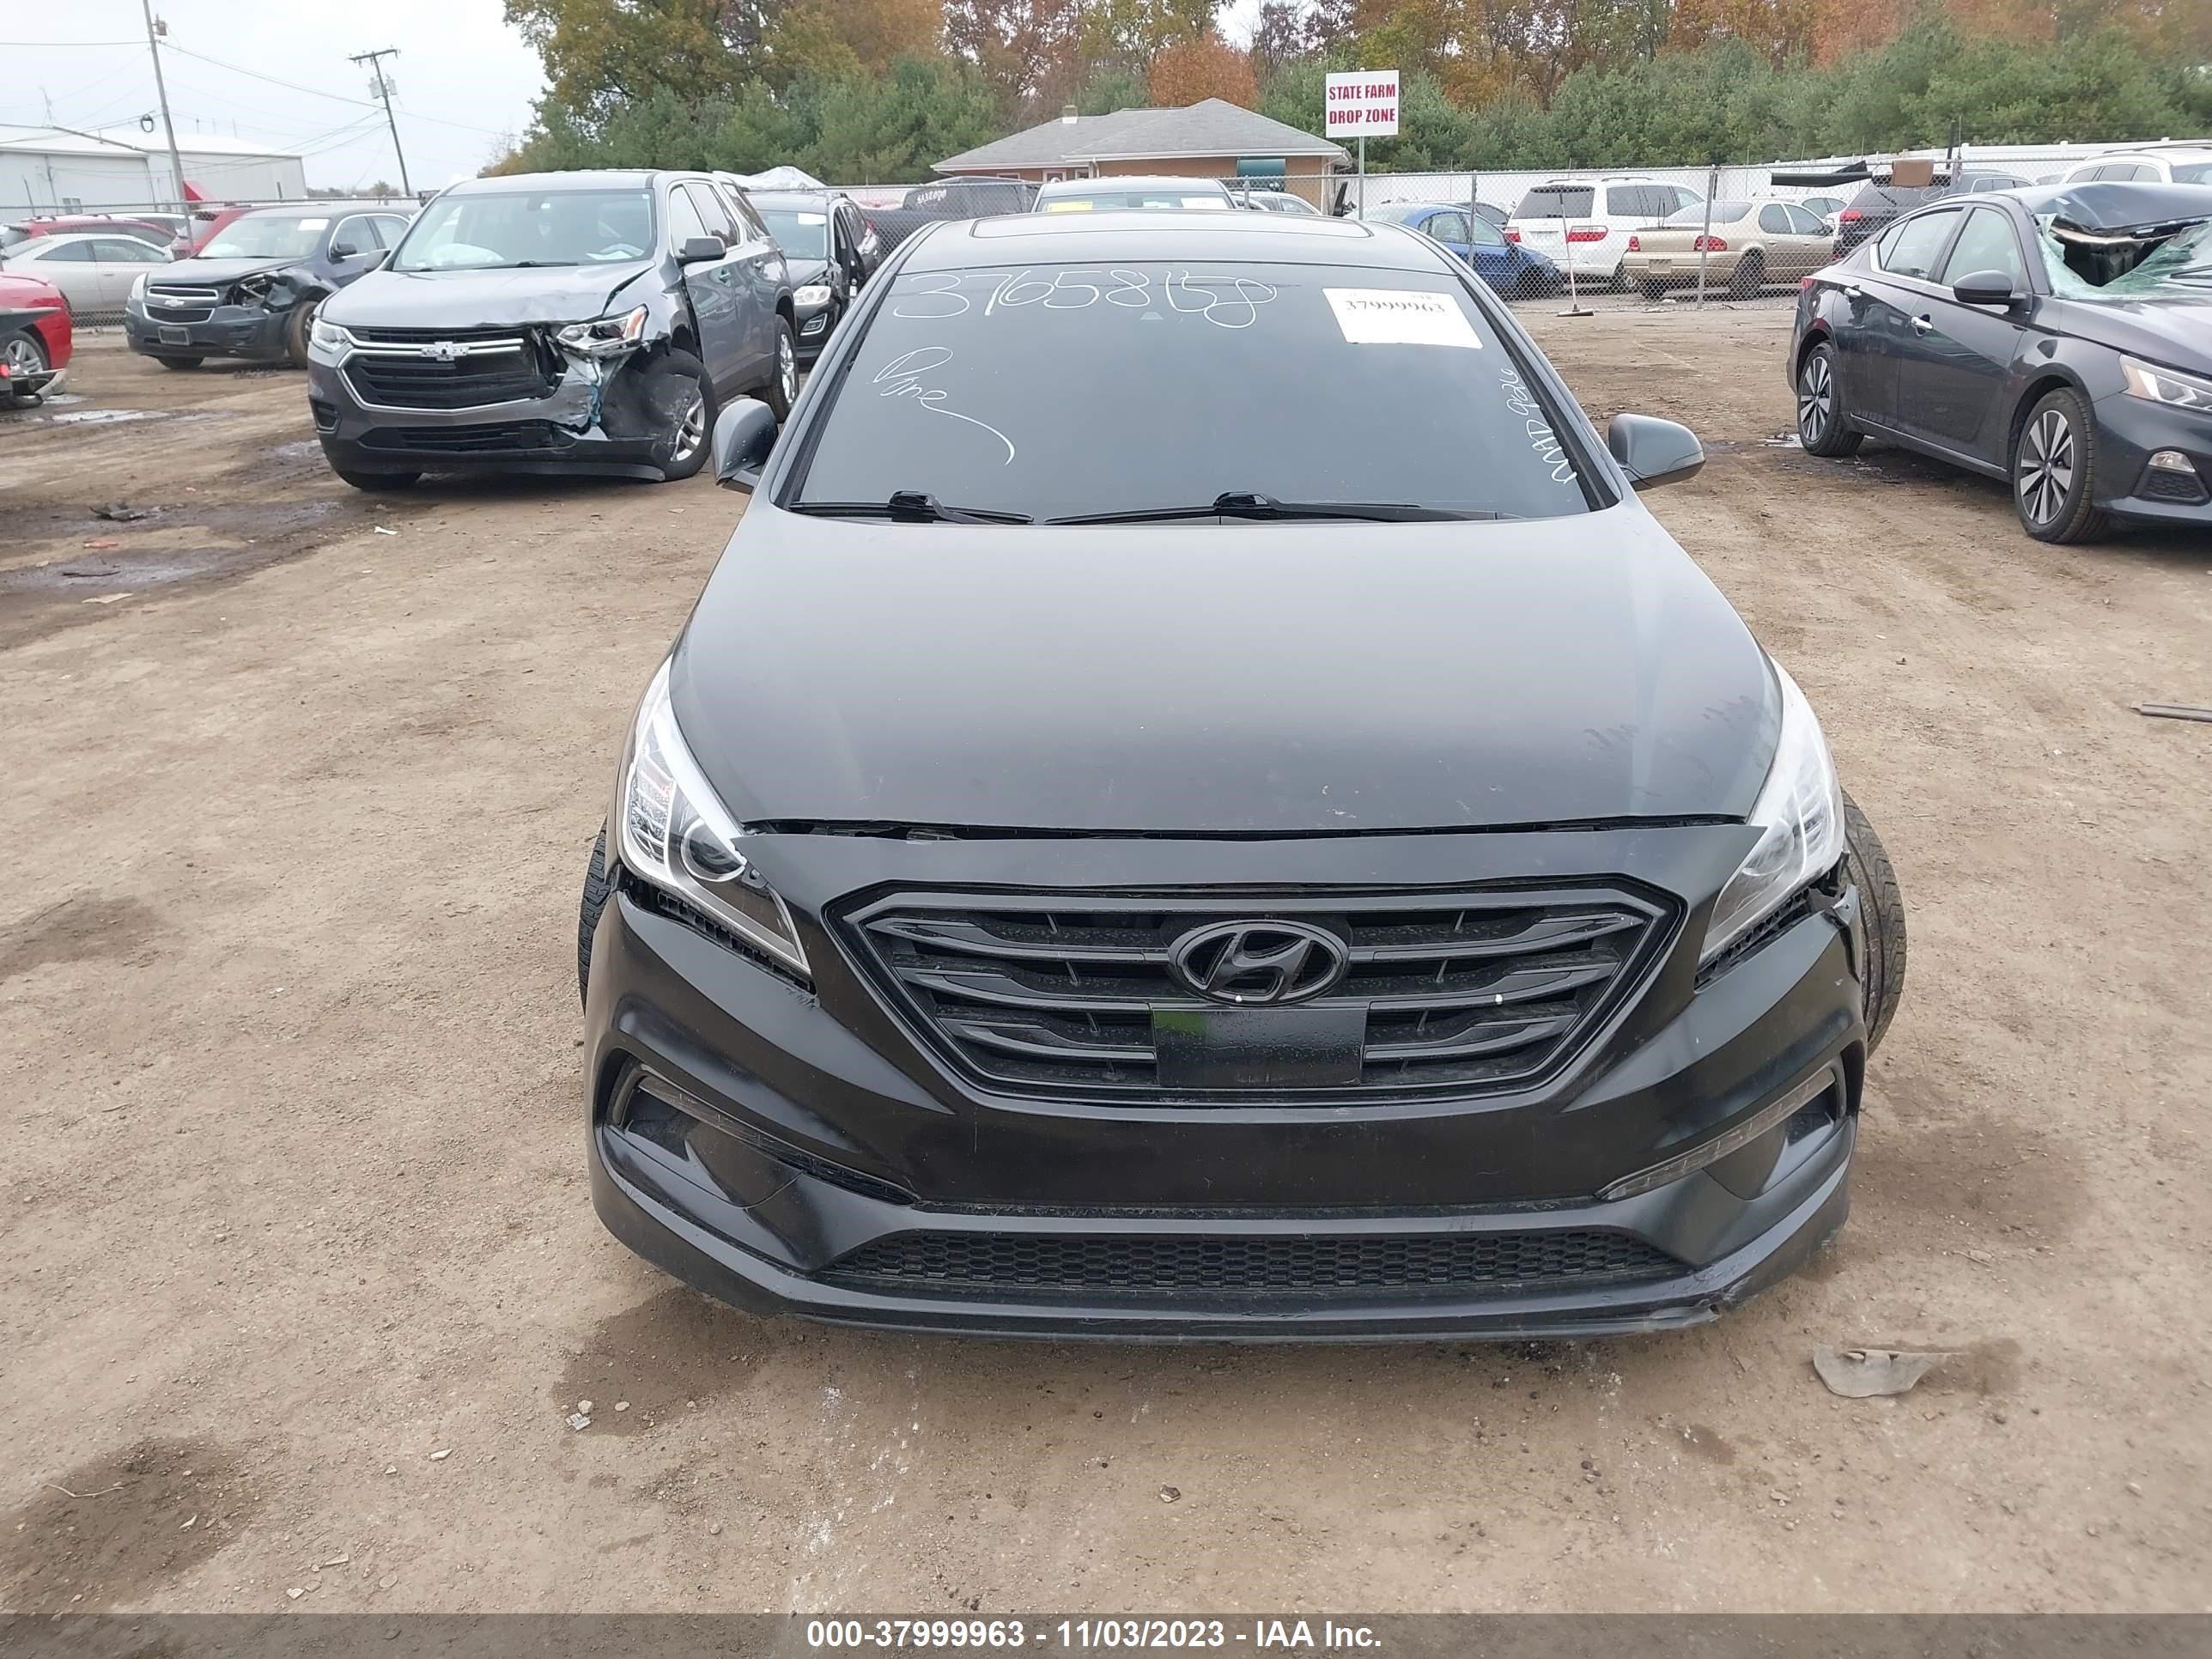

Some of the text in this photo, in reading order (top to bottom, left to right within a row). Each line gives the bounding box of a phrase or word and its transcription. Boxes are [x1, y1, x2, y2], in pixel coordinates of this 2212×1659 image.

[1329, 84, 1396, 100] STATE FARM
[1329, 108, 1395, 125] DROP ZONE
[1345, 301, 1446, 313] 37999963
